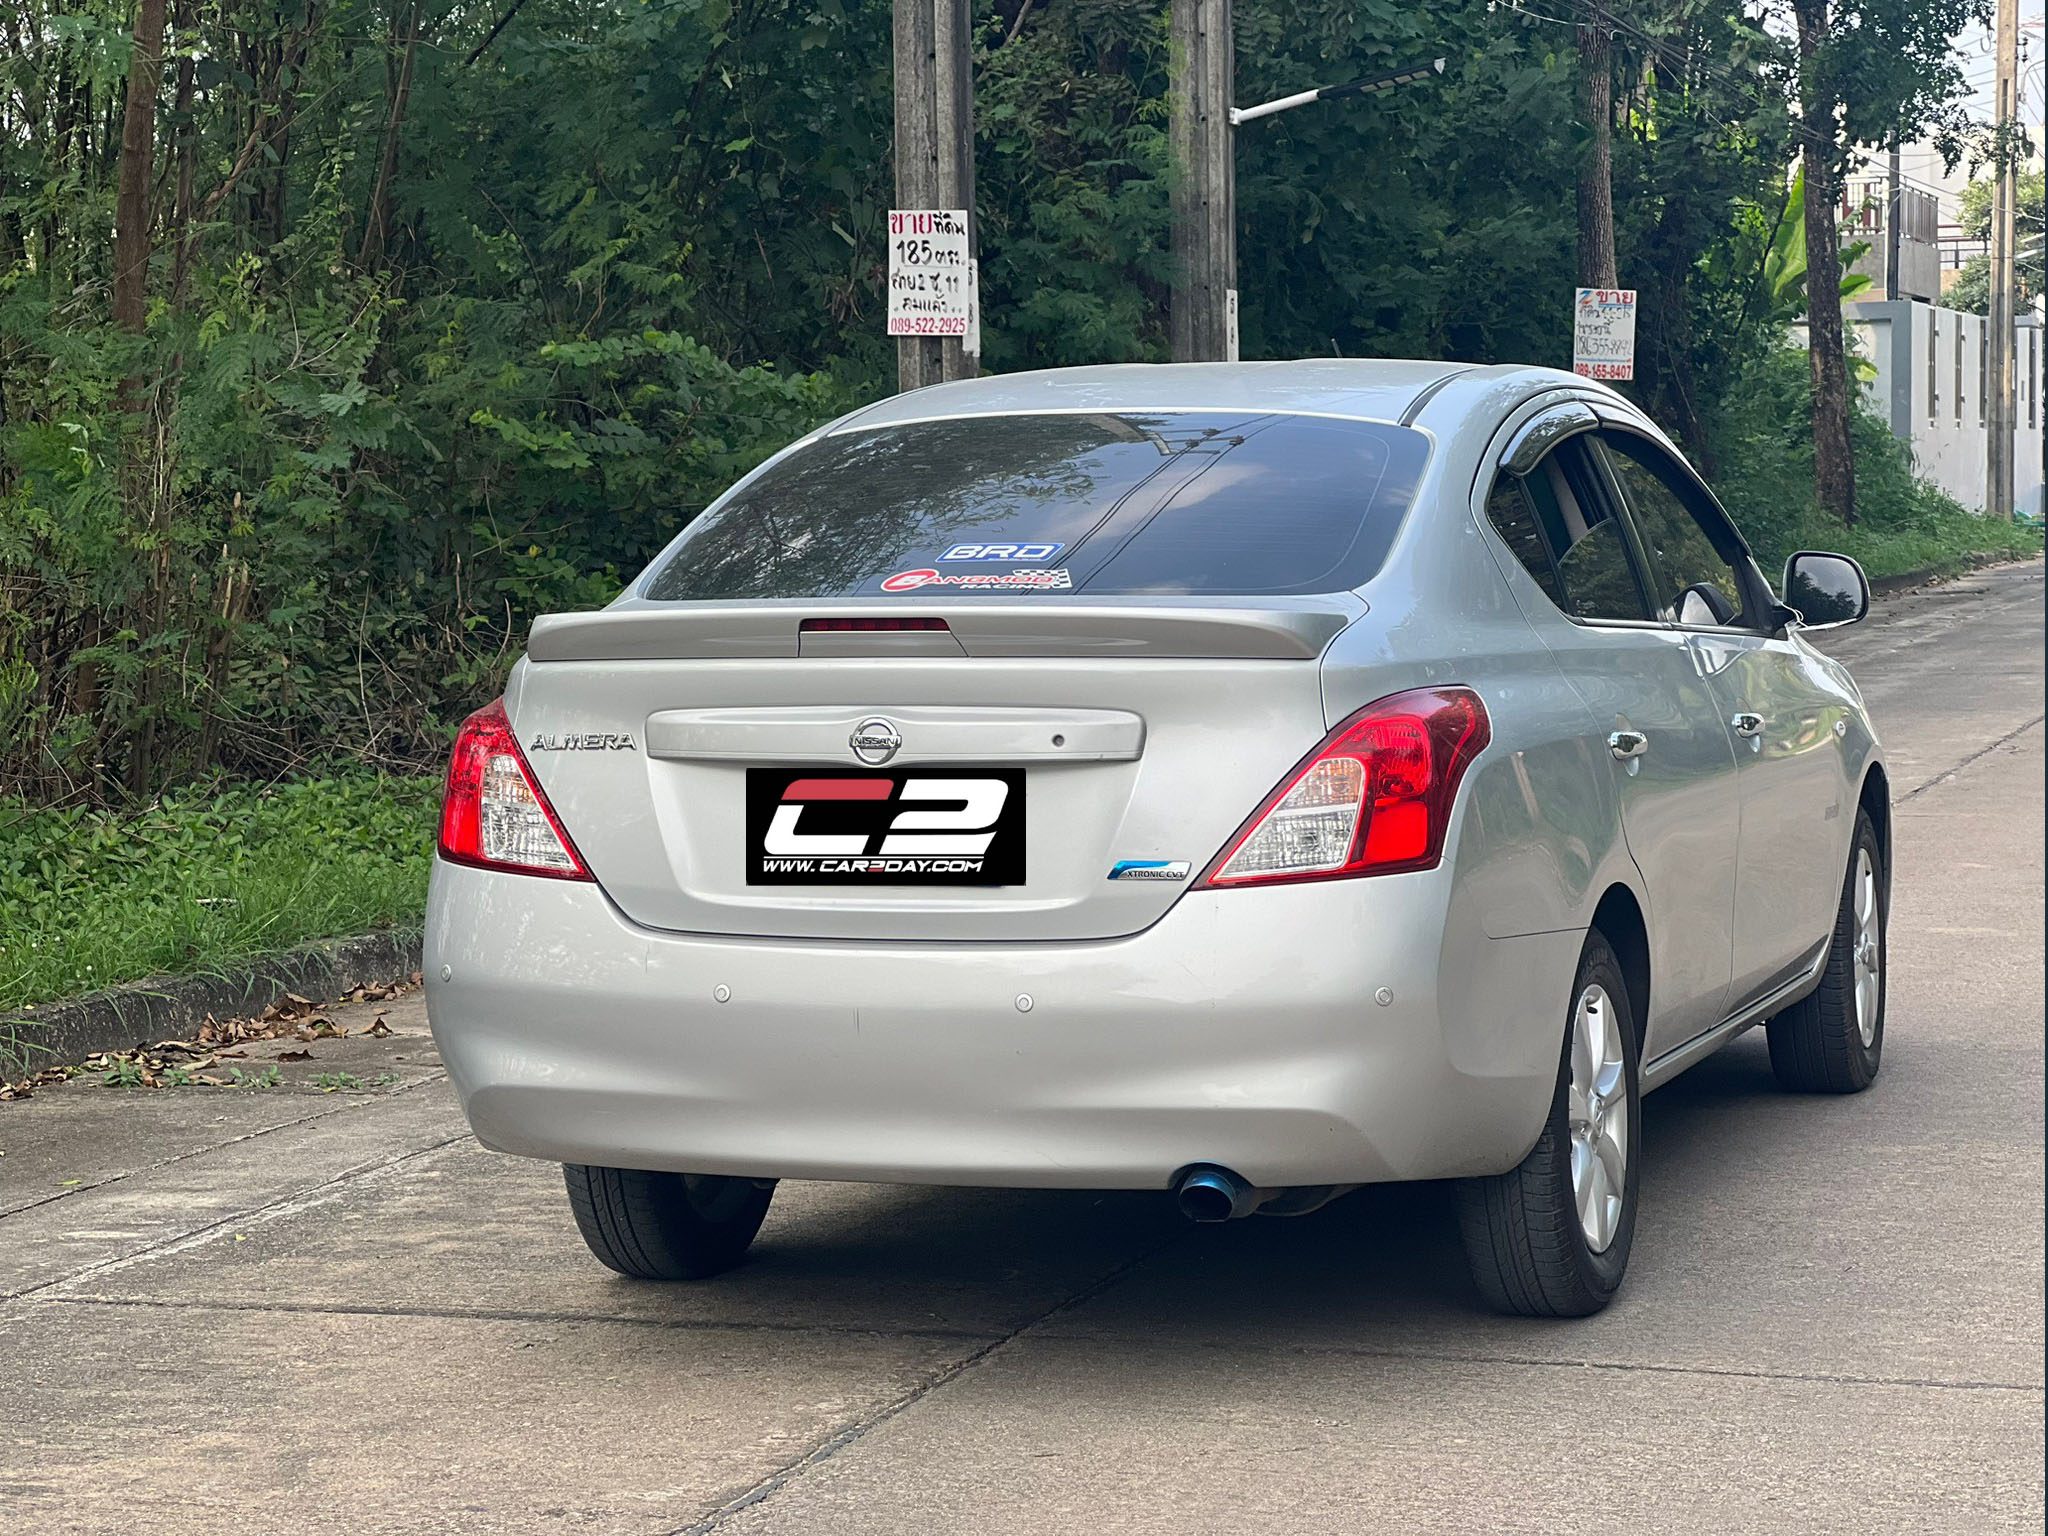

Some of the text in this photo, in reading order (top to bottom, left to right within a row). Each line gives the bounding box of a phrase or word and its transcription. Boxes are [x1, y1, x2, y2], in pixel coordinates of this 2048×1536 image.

[896, 239, 932, 265] 185
[1595, 290, 1634, 305] ขาย
[890, 317, 966, 333] 089-522-2925
[943, 545, 1055, 559] BRD
[530, 732, 637, 751] ALMERA
[854, 736, 898, 747] NISSAN
[1127, 870, 1185, 878] XTRONIC CVT
